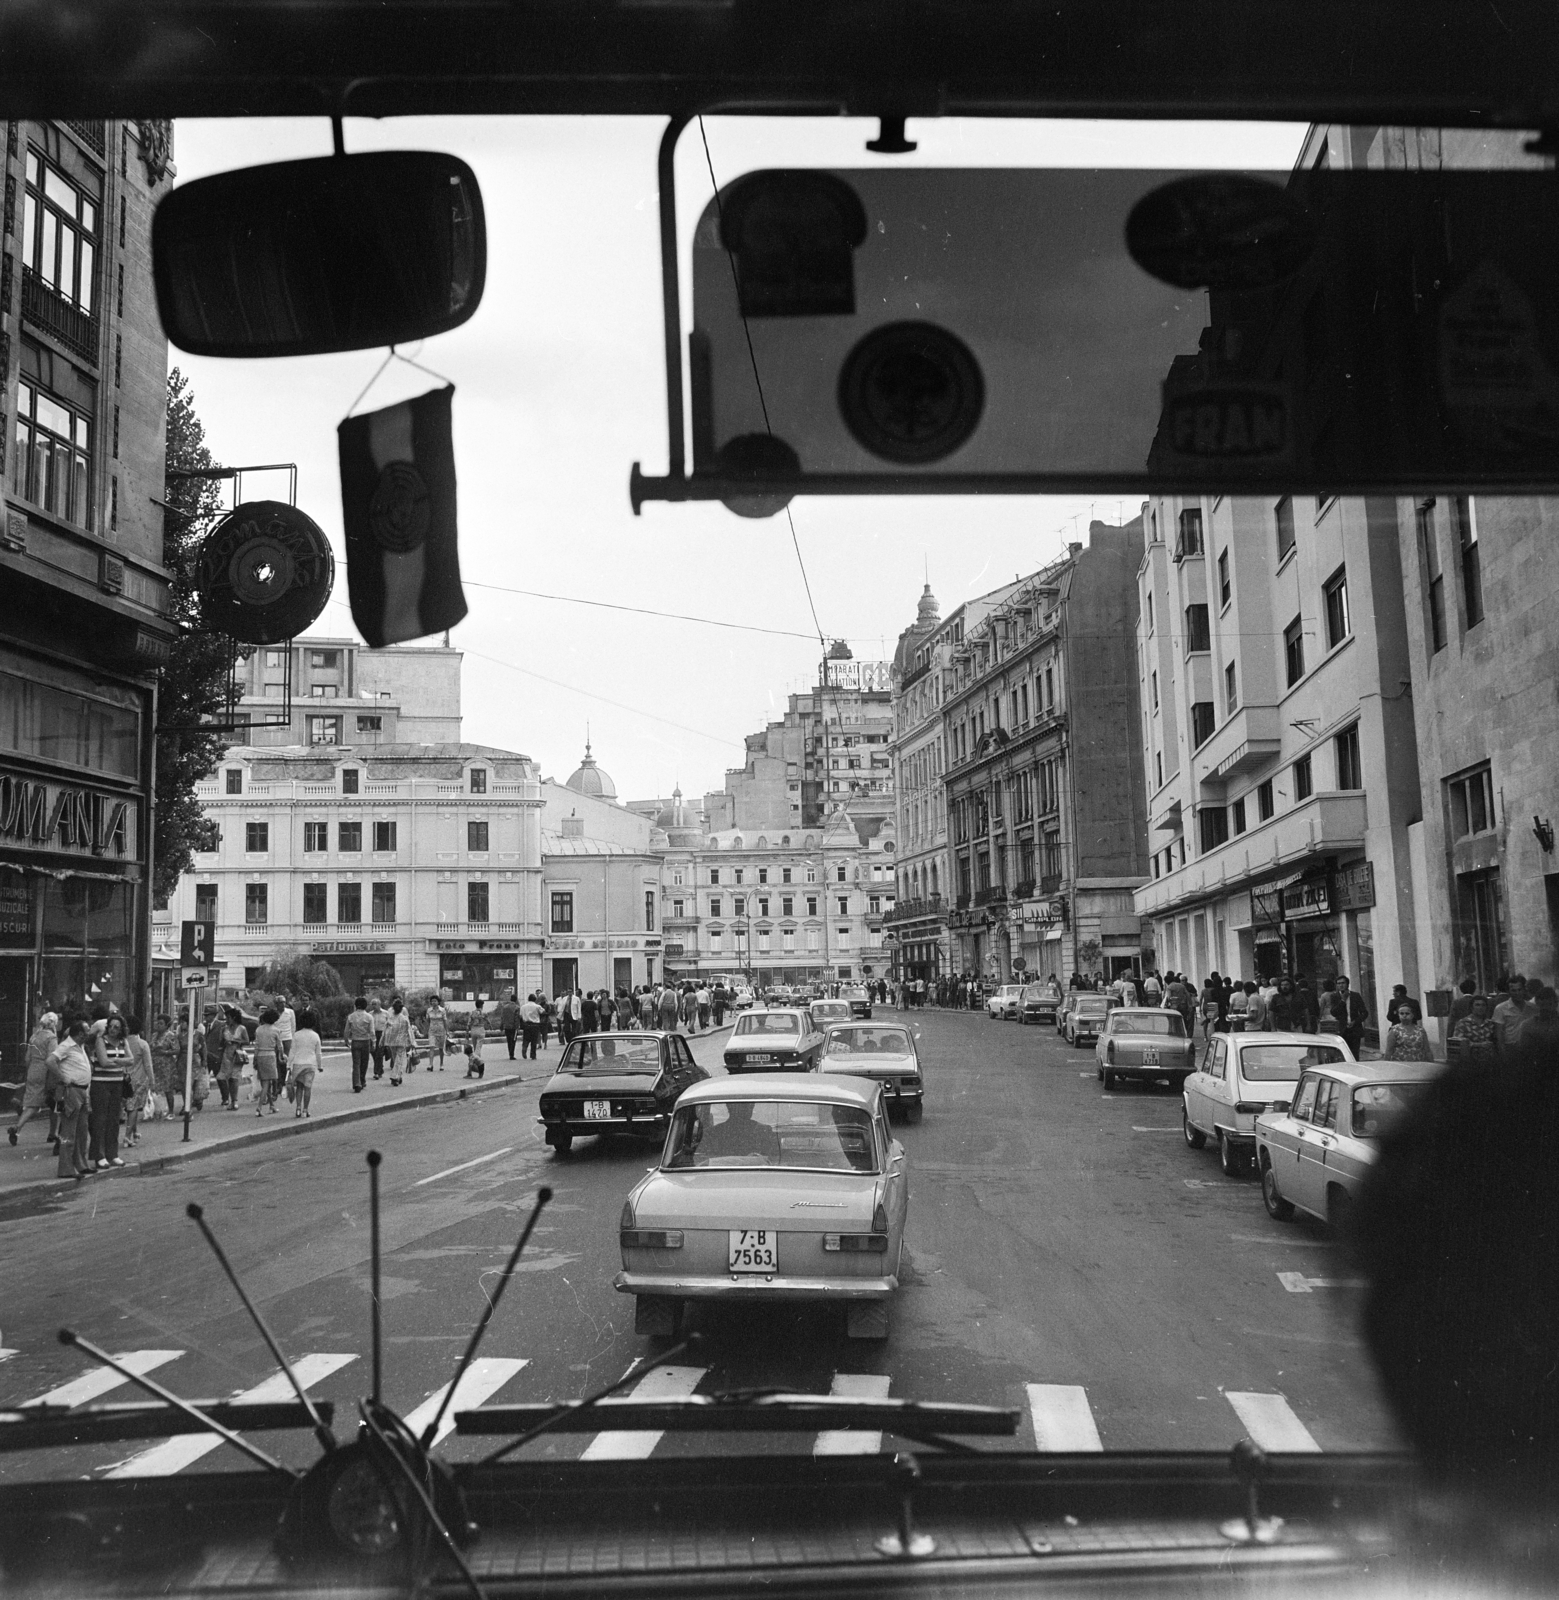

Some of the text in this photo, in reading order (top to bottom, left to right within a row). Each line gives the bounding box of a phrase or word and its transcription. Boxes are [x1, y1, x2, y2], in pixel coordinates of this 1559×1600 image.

[194, 924, 205, 947] P
[310, 940, 386, 952] Parfumerie
[436, 941, 521, 950] Loto Prono
[590, 1101, 605, 1109] 1-B
[733, 1249, 773, 1266] 7563
